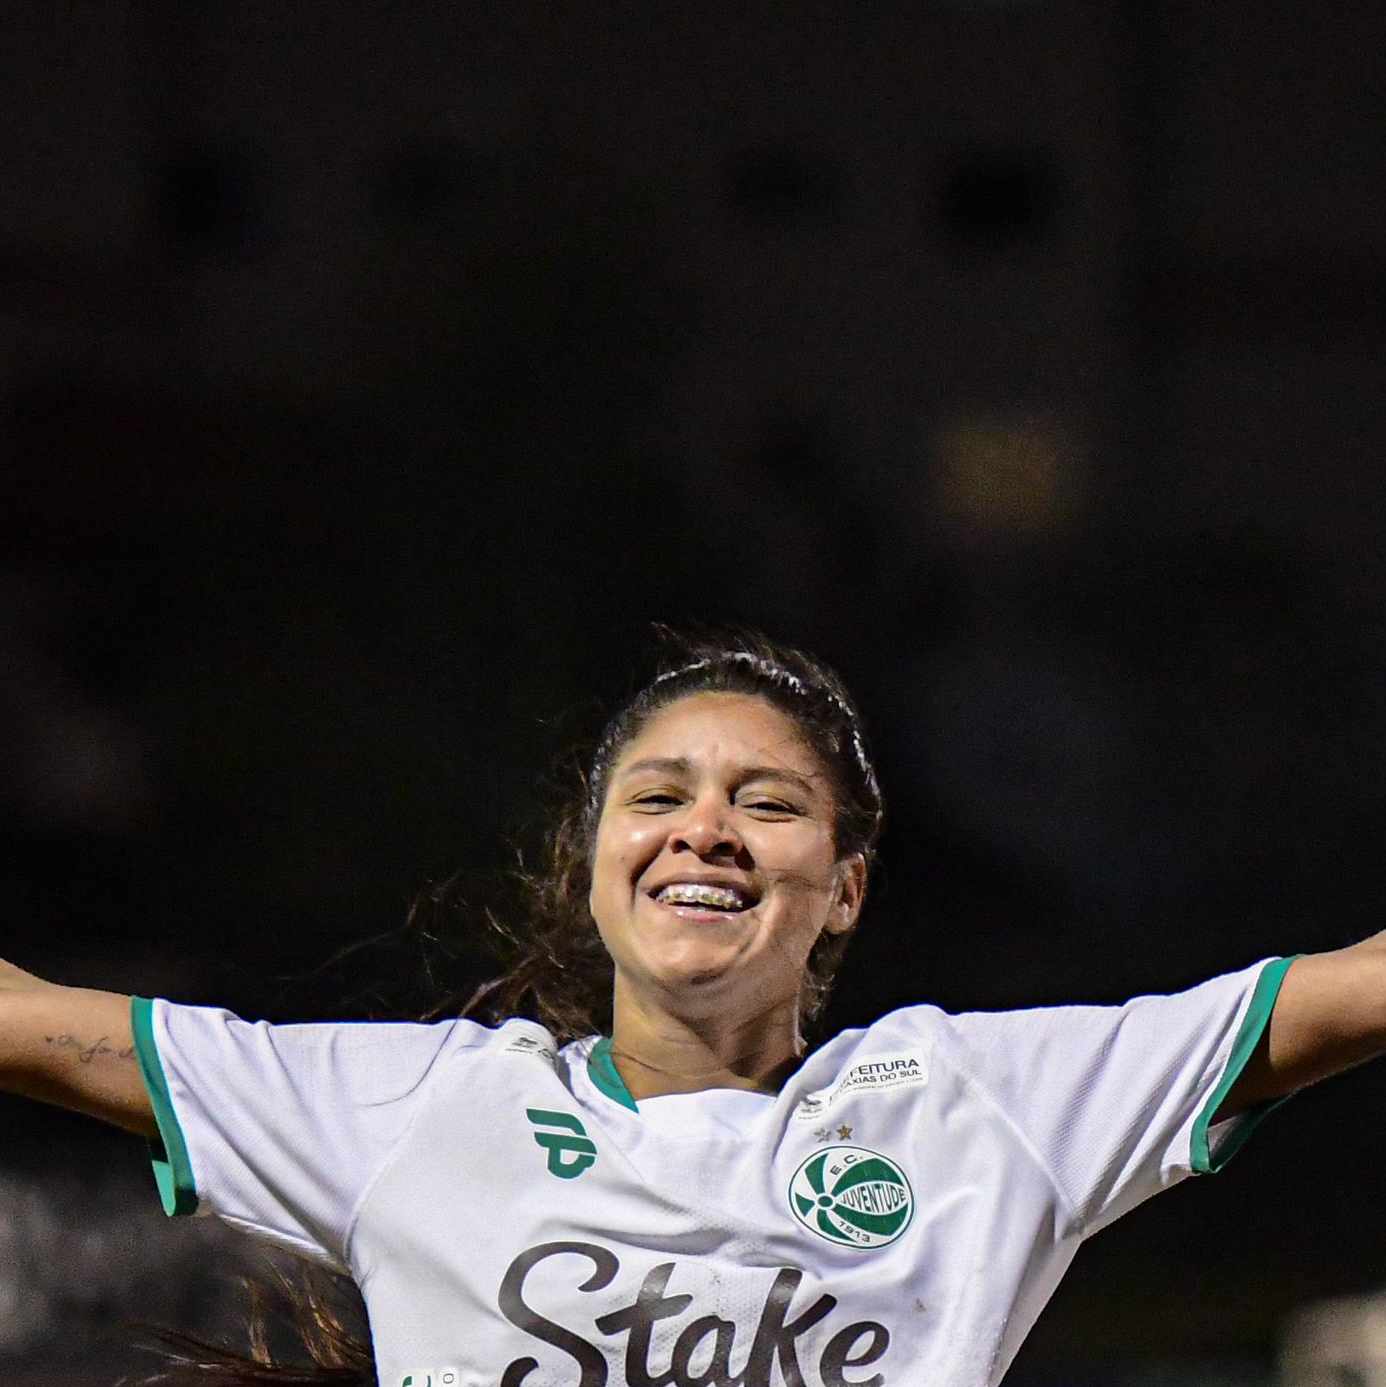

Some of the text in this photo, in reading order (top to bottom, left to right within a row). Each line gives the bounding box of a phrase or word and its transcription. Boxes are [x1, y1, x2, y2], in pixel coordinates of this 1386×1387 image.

[879, 1072, 898, 1083] DO
[900, 1069, 923, 1079] SUL
[829, 1154, 864, 1176] E.C.
[841, 1182, 906, 1213] JUVENTUDE
[838, 1220, 871, 1243] 1913
